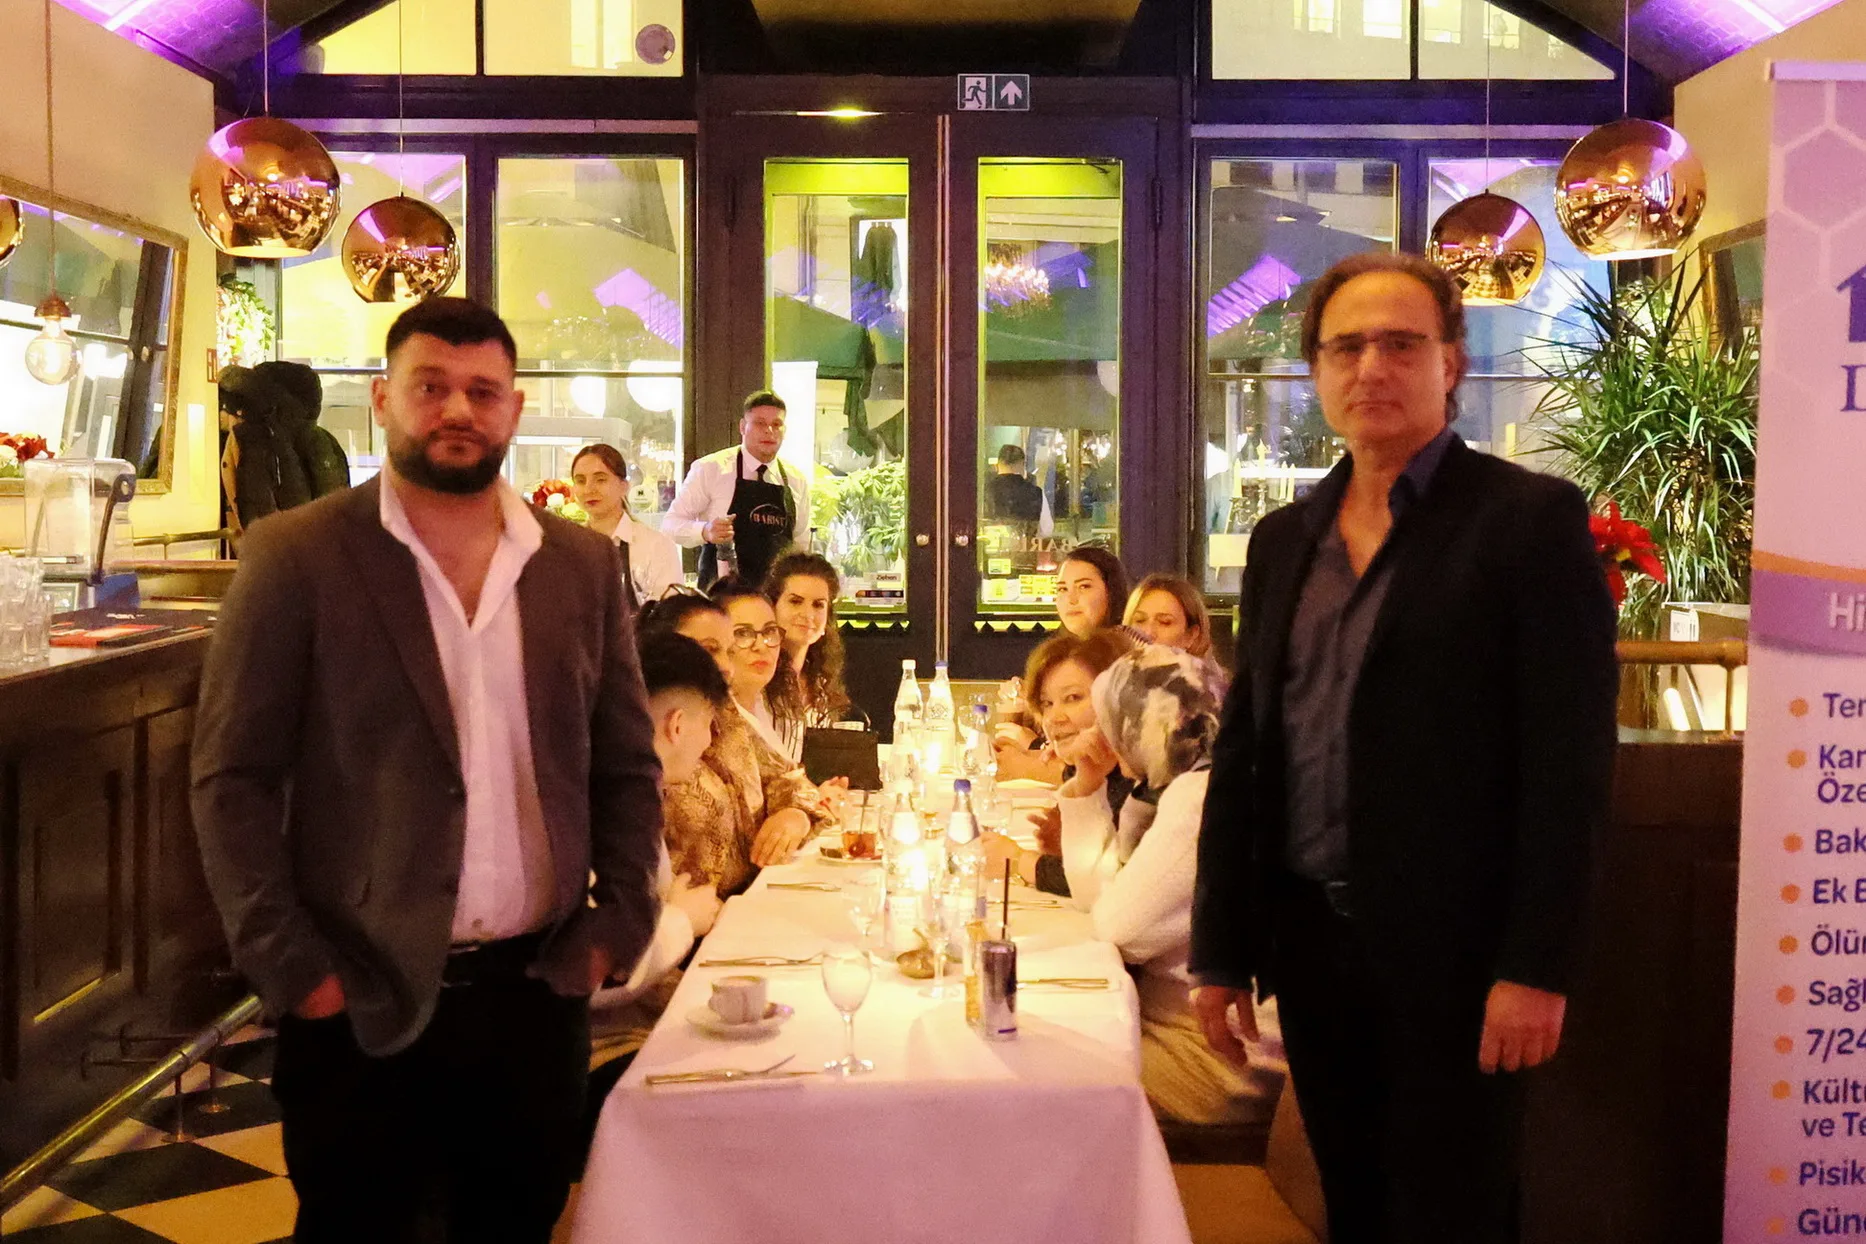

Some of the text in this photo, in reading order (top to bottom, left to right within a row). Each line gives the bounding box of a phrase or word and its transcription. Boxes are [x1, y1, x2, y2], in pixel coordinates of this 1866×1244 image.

[1815, 828, 1866, 855] Bak
[1812, 877, 1847, 904] Ek
[1811, 923, 1866, 956] Ölü
[1803, 1077, 1866, 1104] Kült
[1801, 1117, 1835, 1138] ve
[1797, 1206, 1866, 1236] Gün
